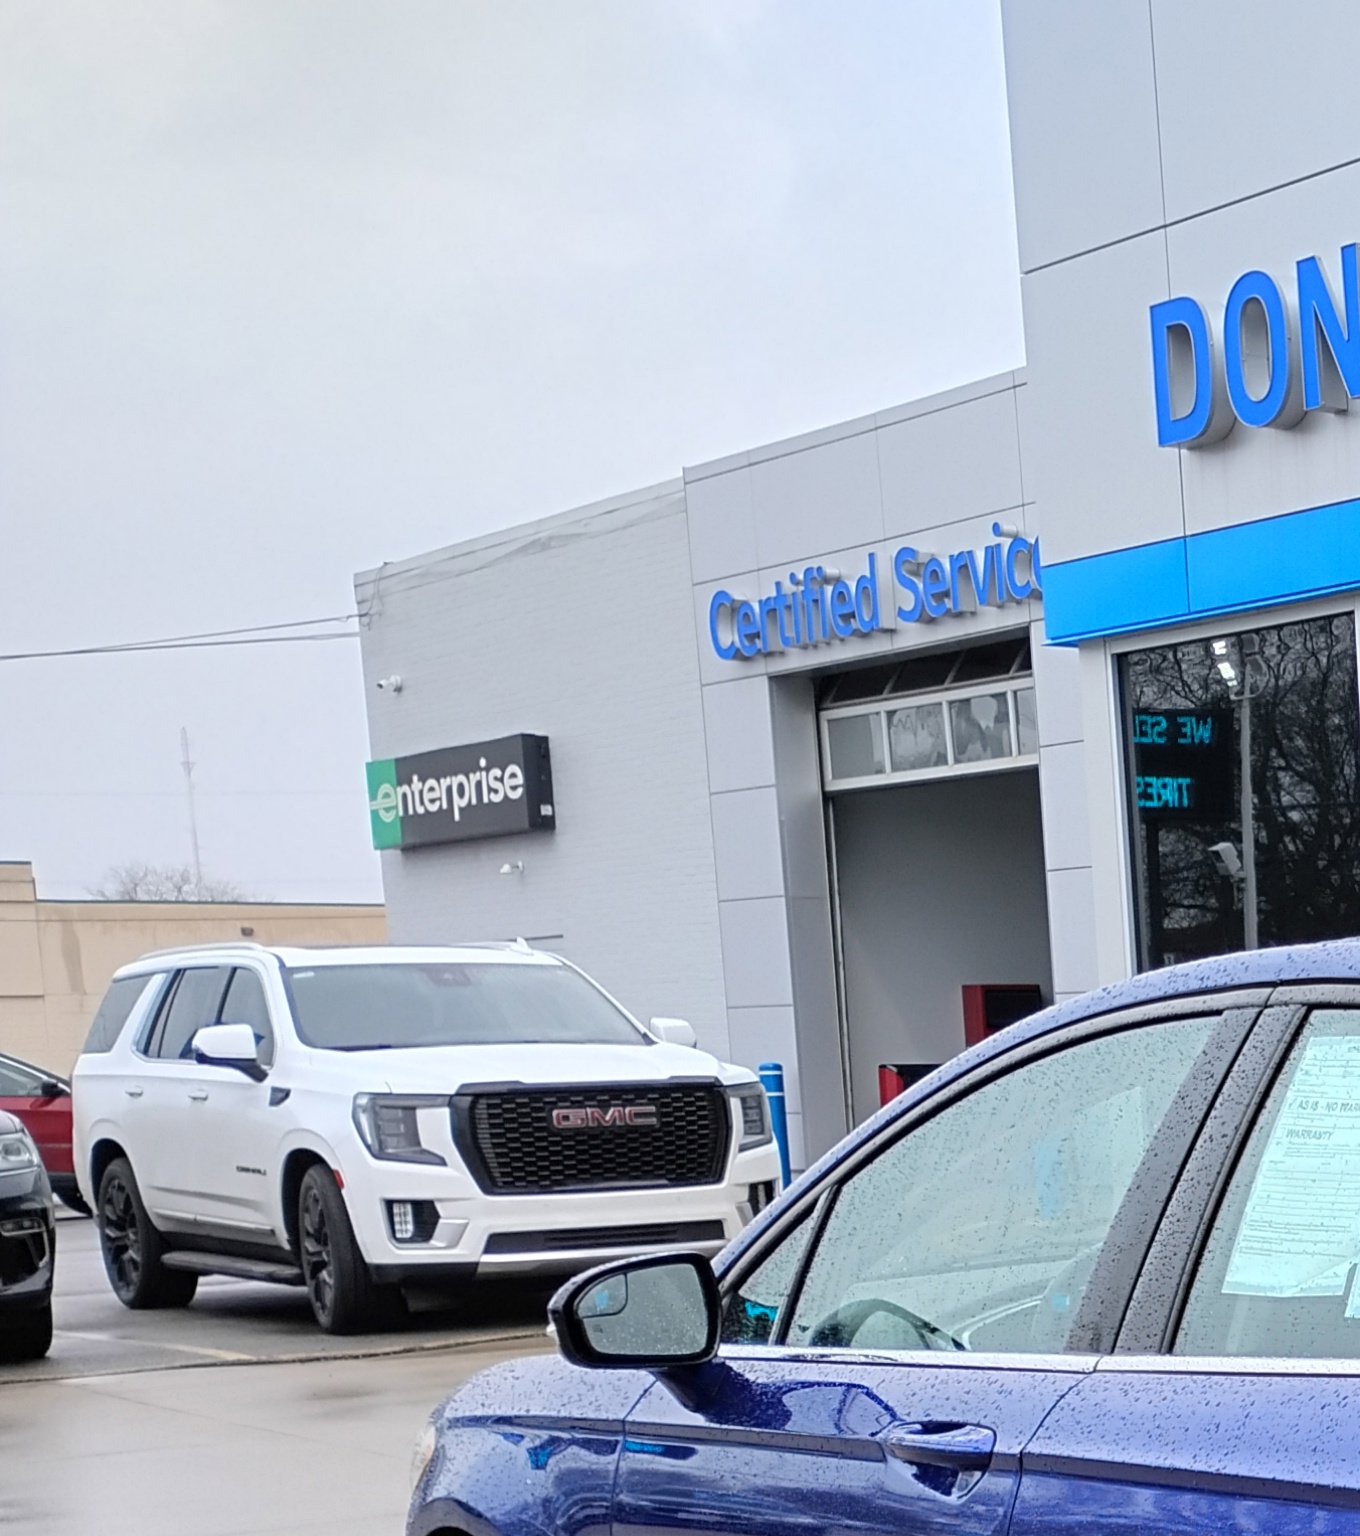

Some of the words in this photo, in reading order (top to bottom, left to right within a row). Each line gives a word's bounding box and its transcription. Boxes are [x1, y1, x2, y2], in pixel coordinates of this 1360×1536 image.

[709, 566, 882, 661] Certified
[371, 757, 524, 822] enterprise
[552, 1105, 658, 1128] GMC
